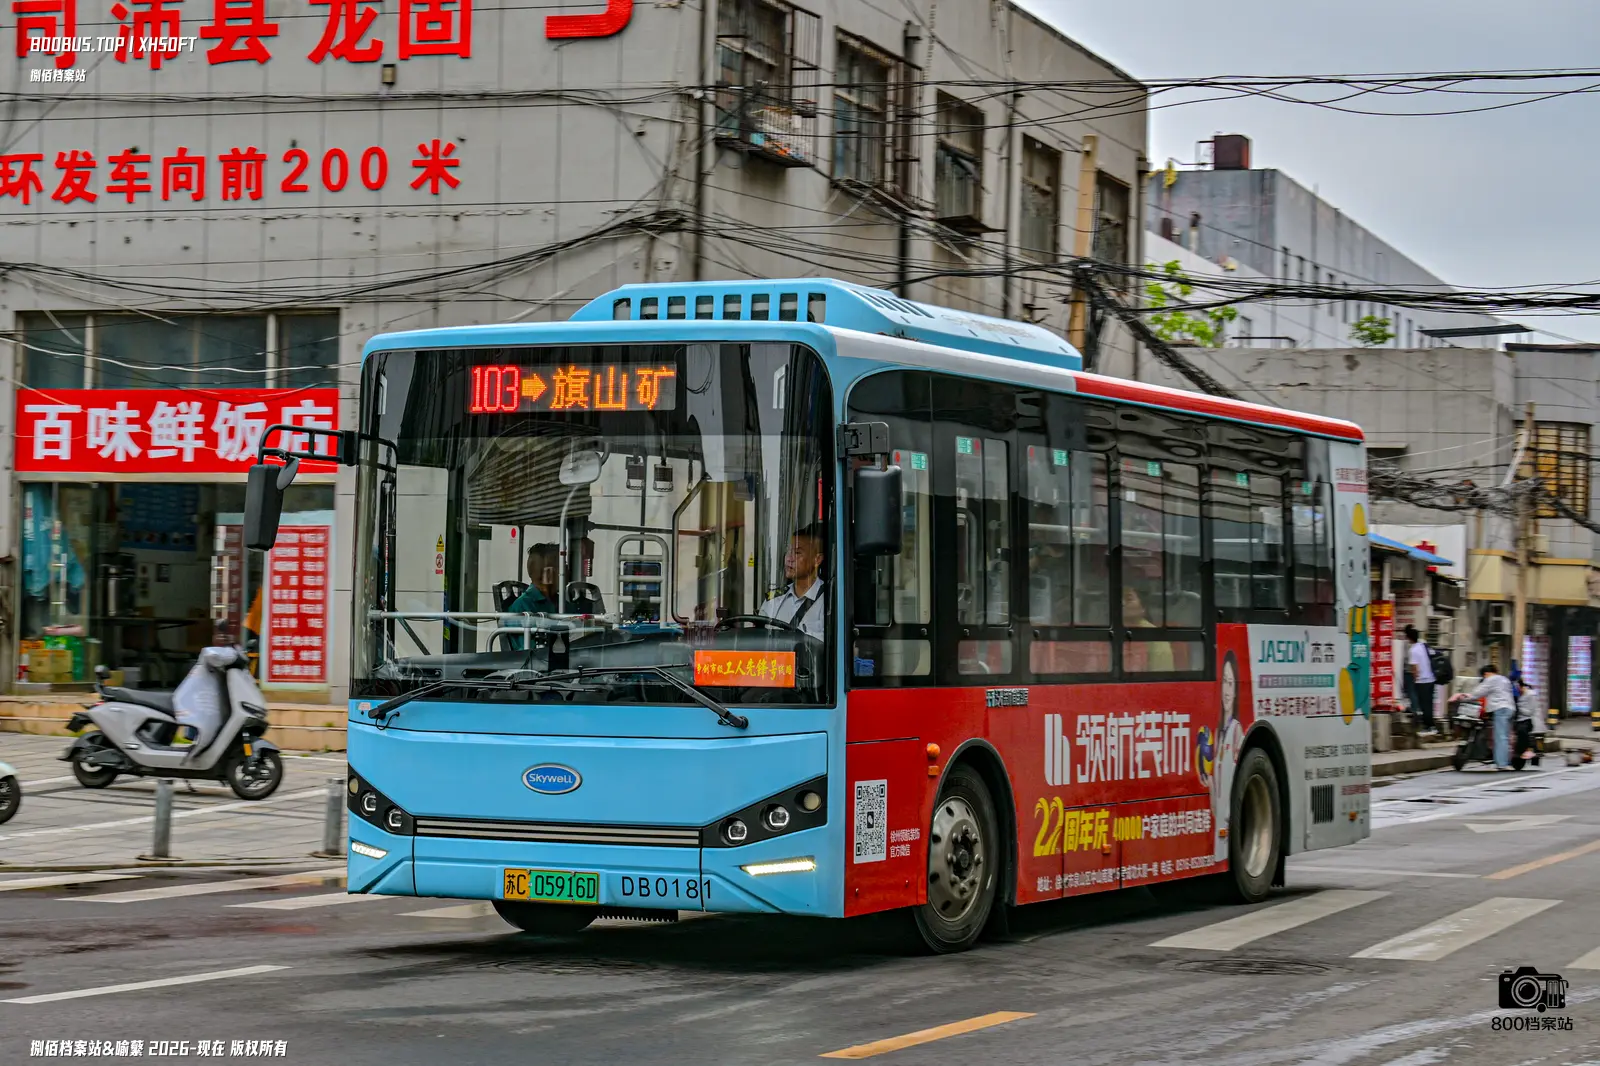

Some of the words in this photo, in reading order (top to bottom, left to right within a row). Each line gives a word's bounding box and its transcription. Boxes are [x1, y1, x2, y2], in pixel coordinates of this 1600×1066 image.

[471, 366, 521, 413] 103
[550, 365, 675, 410] 旗山矿
[24, 400, 334, 462] 百味鲜饭店
[1258, 640, 1305, 663] JASON
[1076, 711, 1190, 783] 领航装饰
[528, 773, 574, 784] Skywell
[621, 876, 711, 899] DB0181
